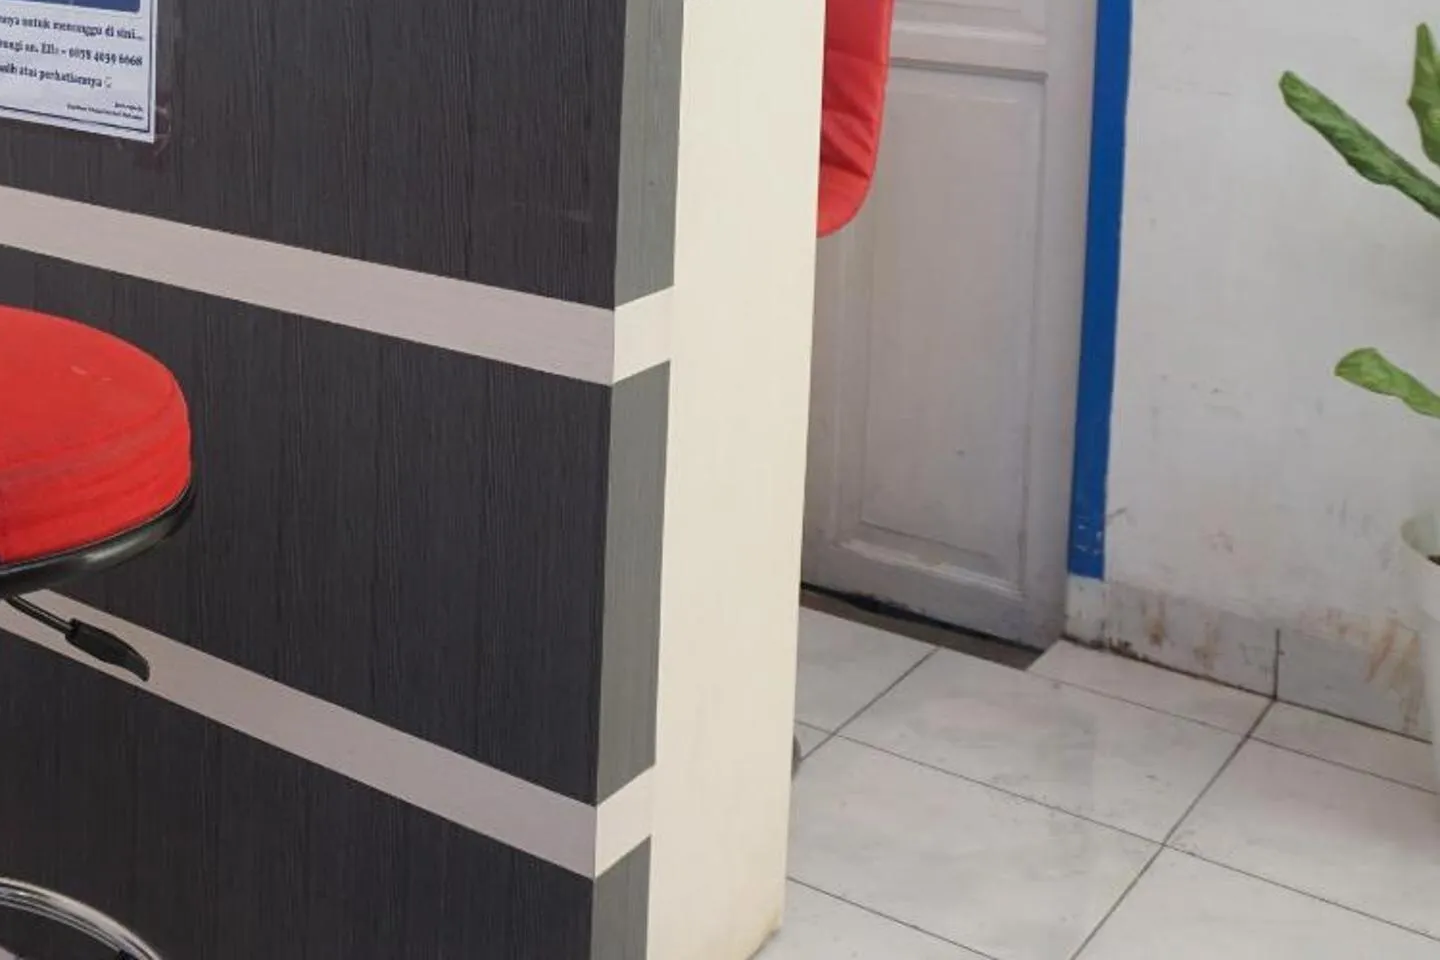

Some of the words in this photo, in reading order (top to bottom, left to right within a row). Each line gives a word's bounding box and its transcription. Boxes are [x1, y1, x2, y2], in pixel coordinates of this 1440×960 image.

[53, 21, 102, 37] menunggu
[105, 25, 114, 37] di
[19, 66, 37, 78] atas
[39, 69, 103, 88] perhatiannya
